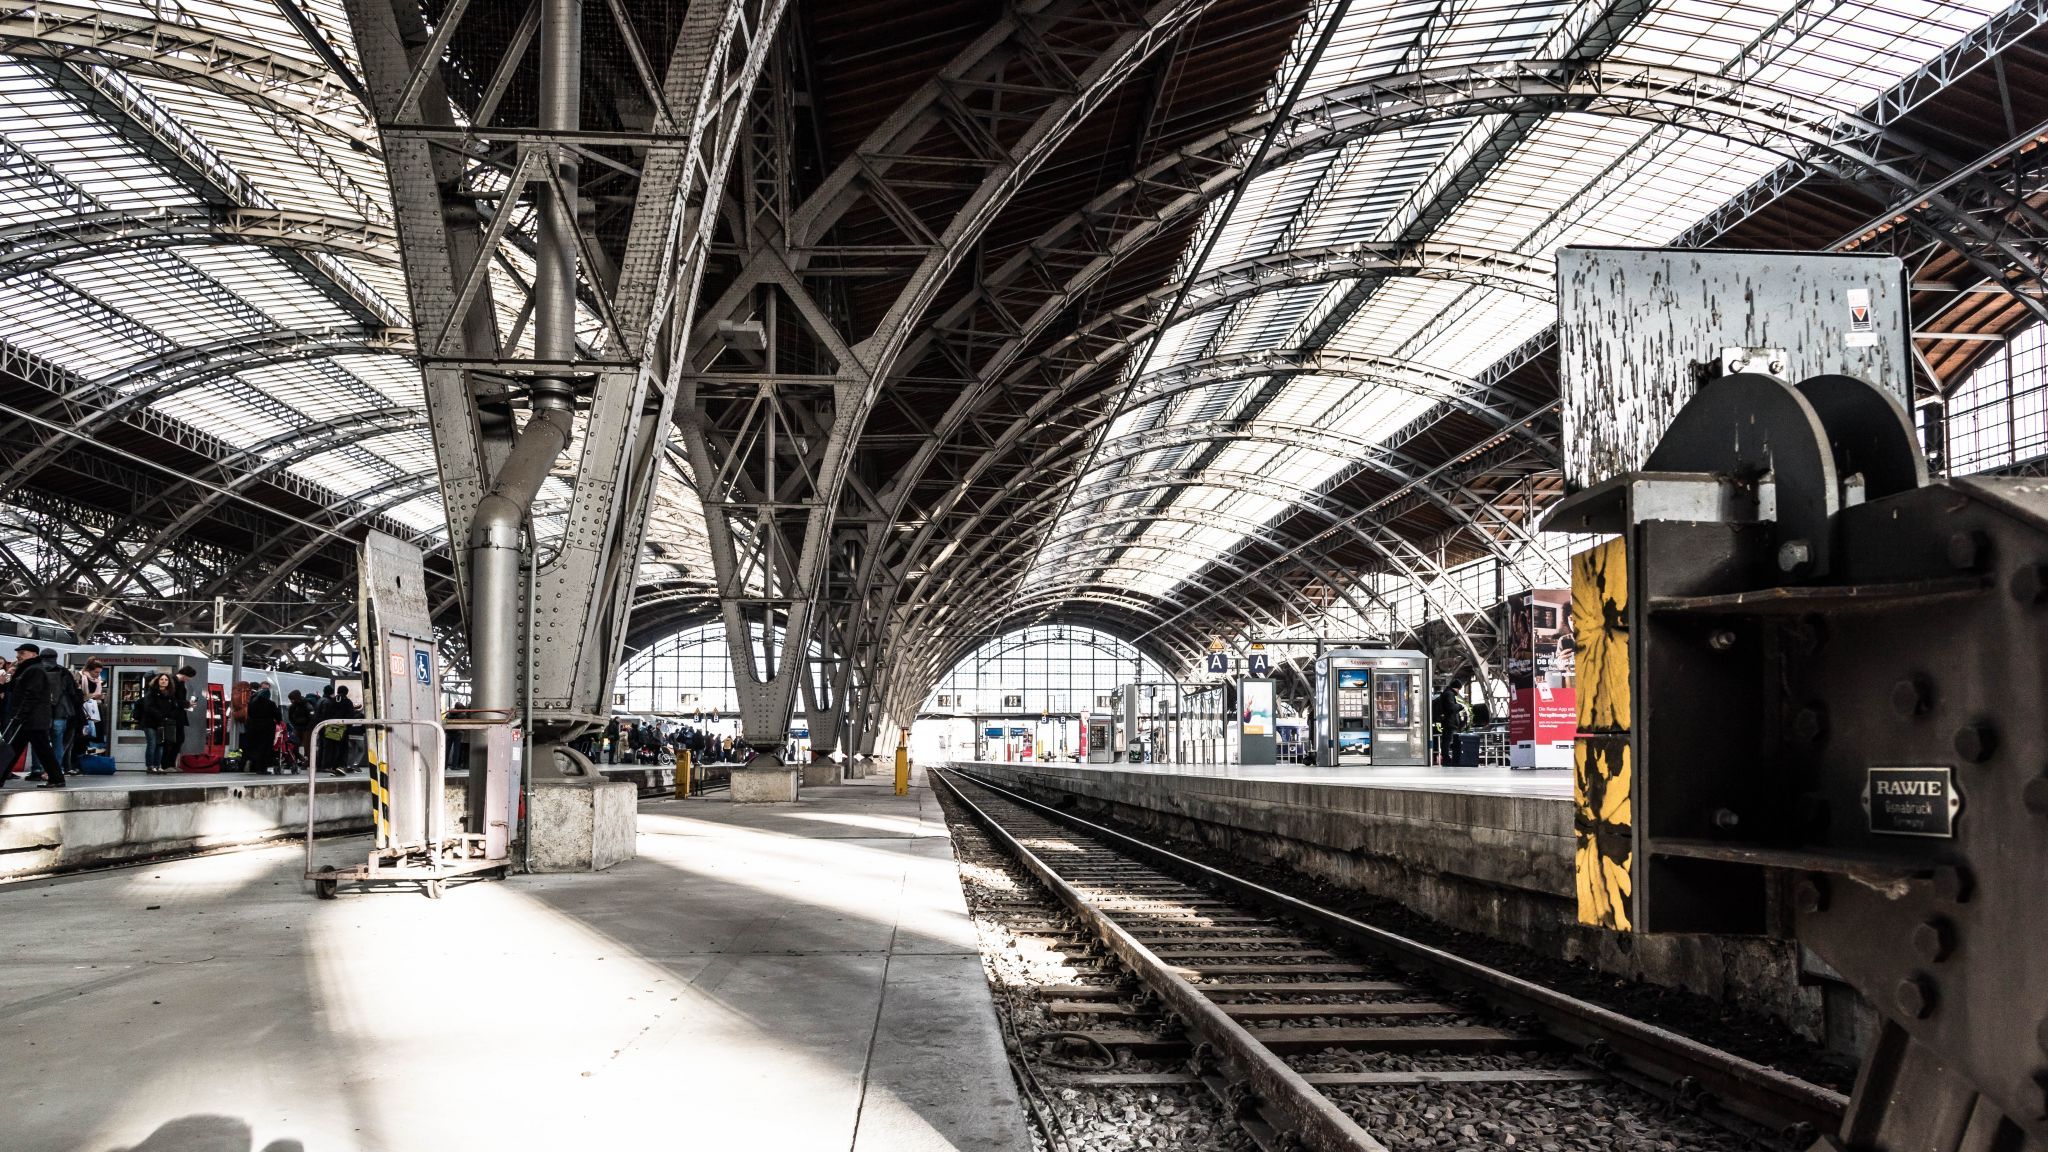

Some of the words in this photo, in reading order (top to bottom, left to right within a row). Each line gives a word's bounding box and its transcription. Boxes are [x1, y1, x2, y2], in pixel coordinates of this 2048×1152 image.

[393, 657, 404, 673] DB
[1211, 655, 1222, 669] A
[1255, 655, 1265, 669] A
[1877, 781, 1941, 796] RAWIE
